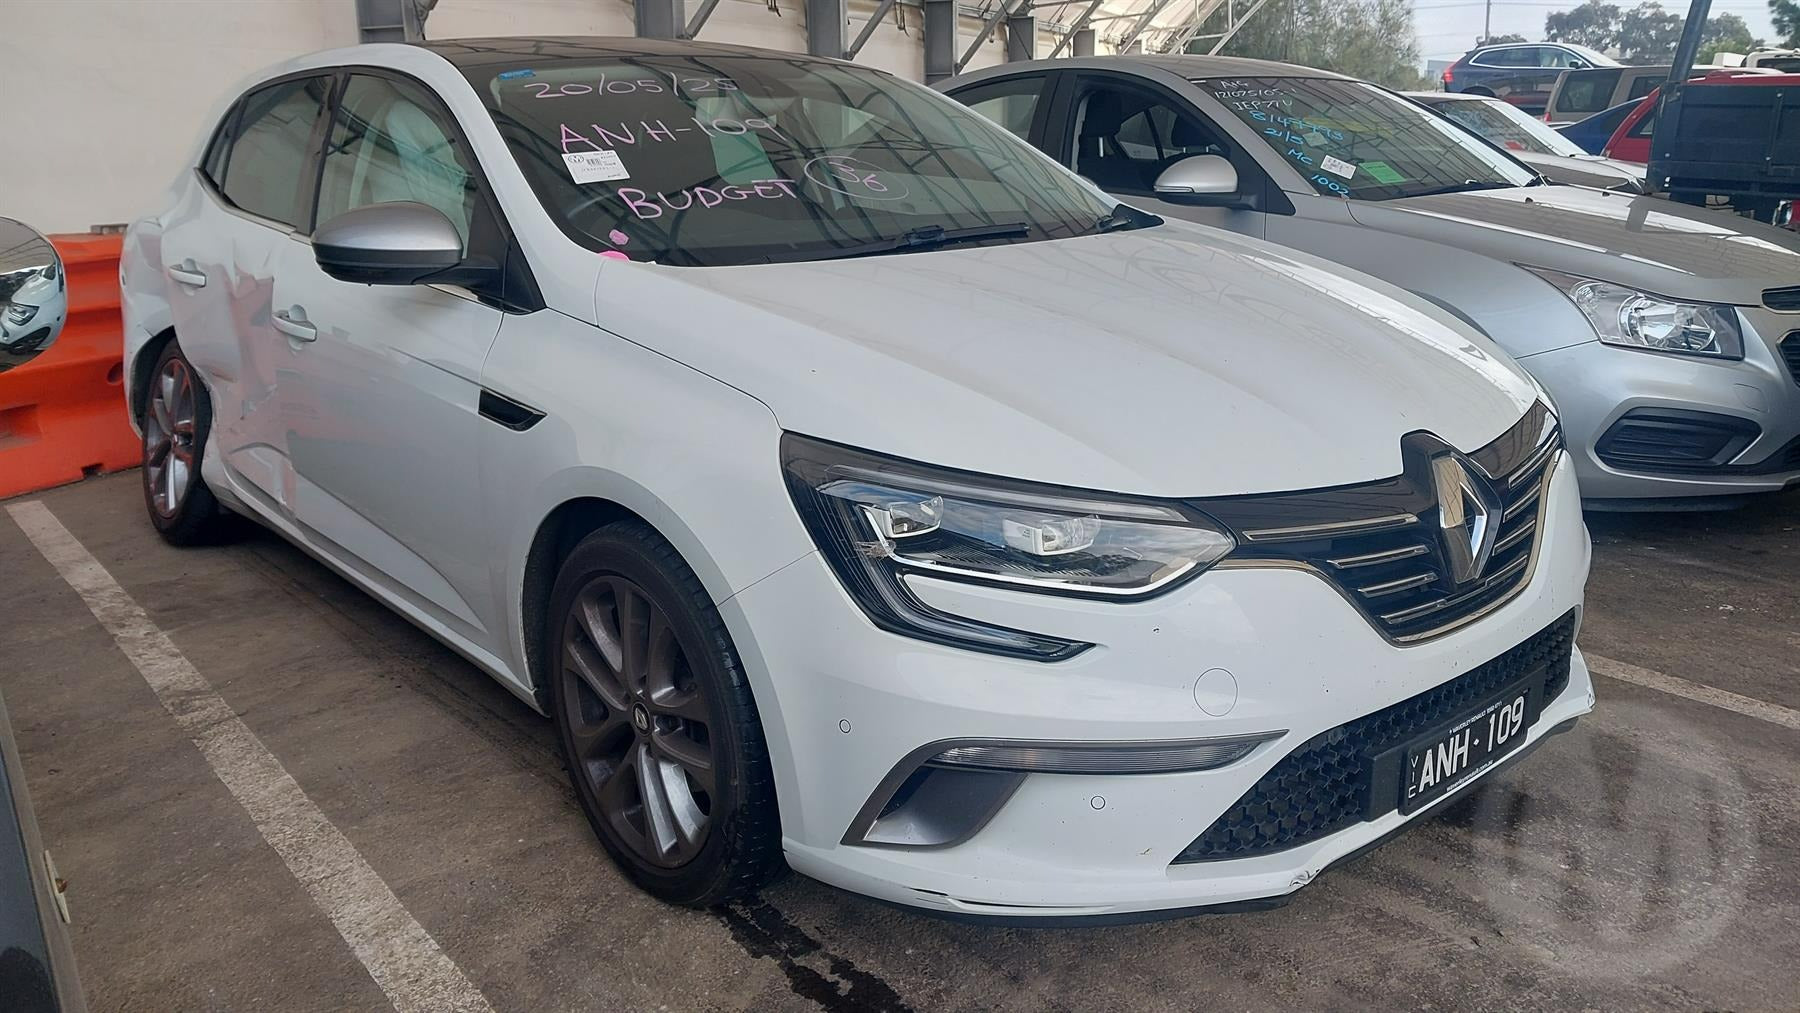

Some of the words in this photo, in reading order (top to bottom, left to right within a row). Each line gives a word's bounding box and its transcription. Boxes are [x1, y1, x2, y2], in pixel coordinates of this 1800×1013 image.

[524, 72, 738, 98] 20/05/25
[560, 116, 788, 154] ANH-109
[617, 179, 797, 219] BUDGET
